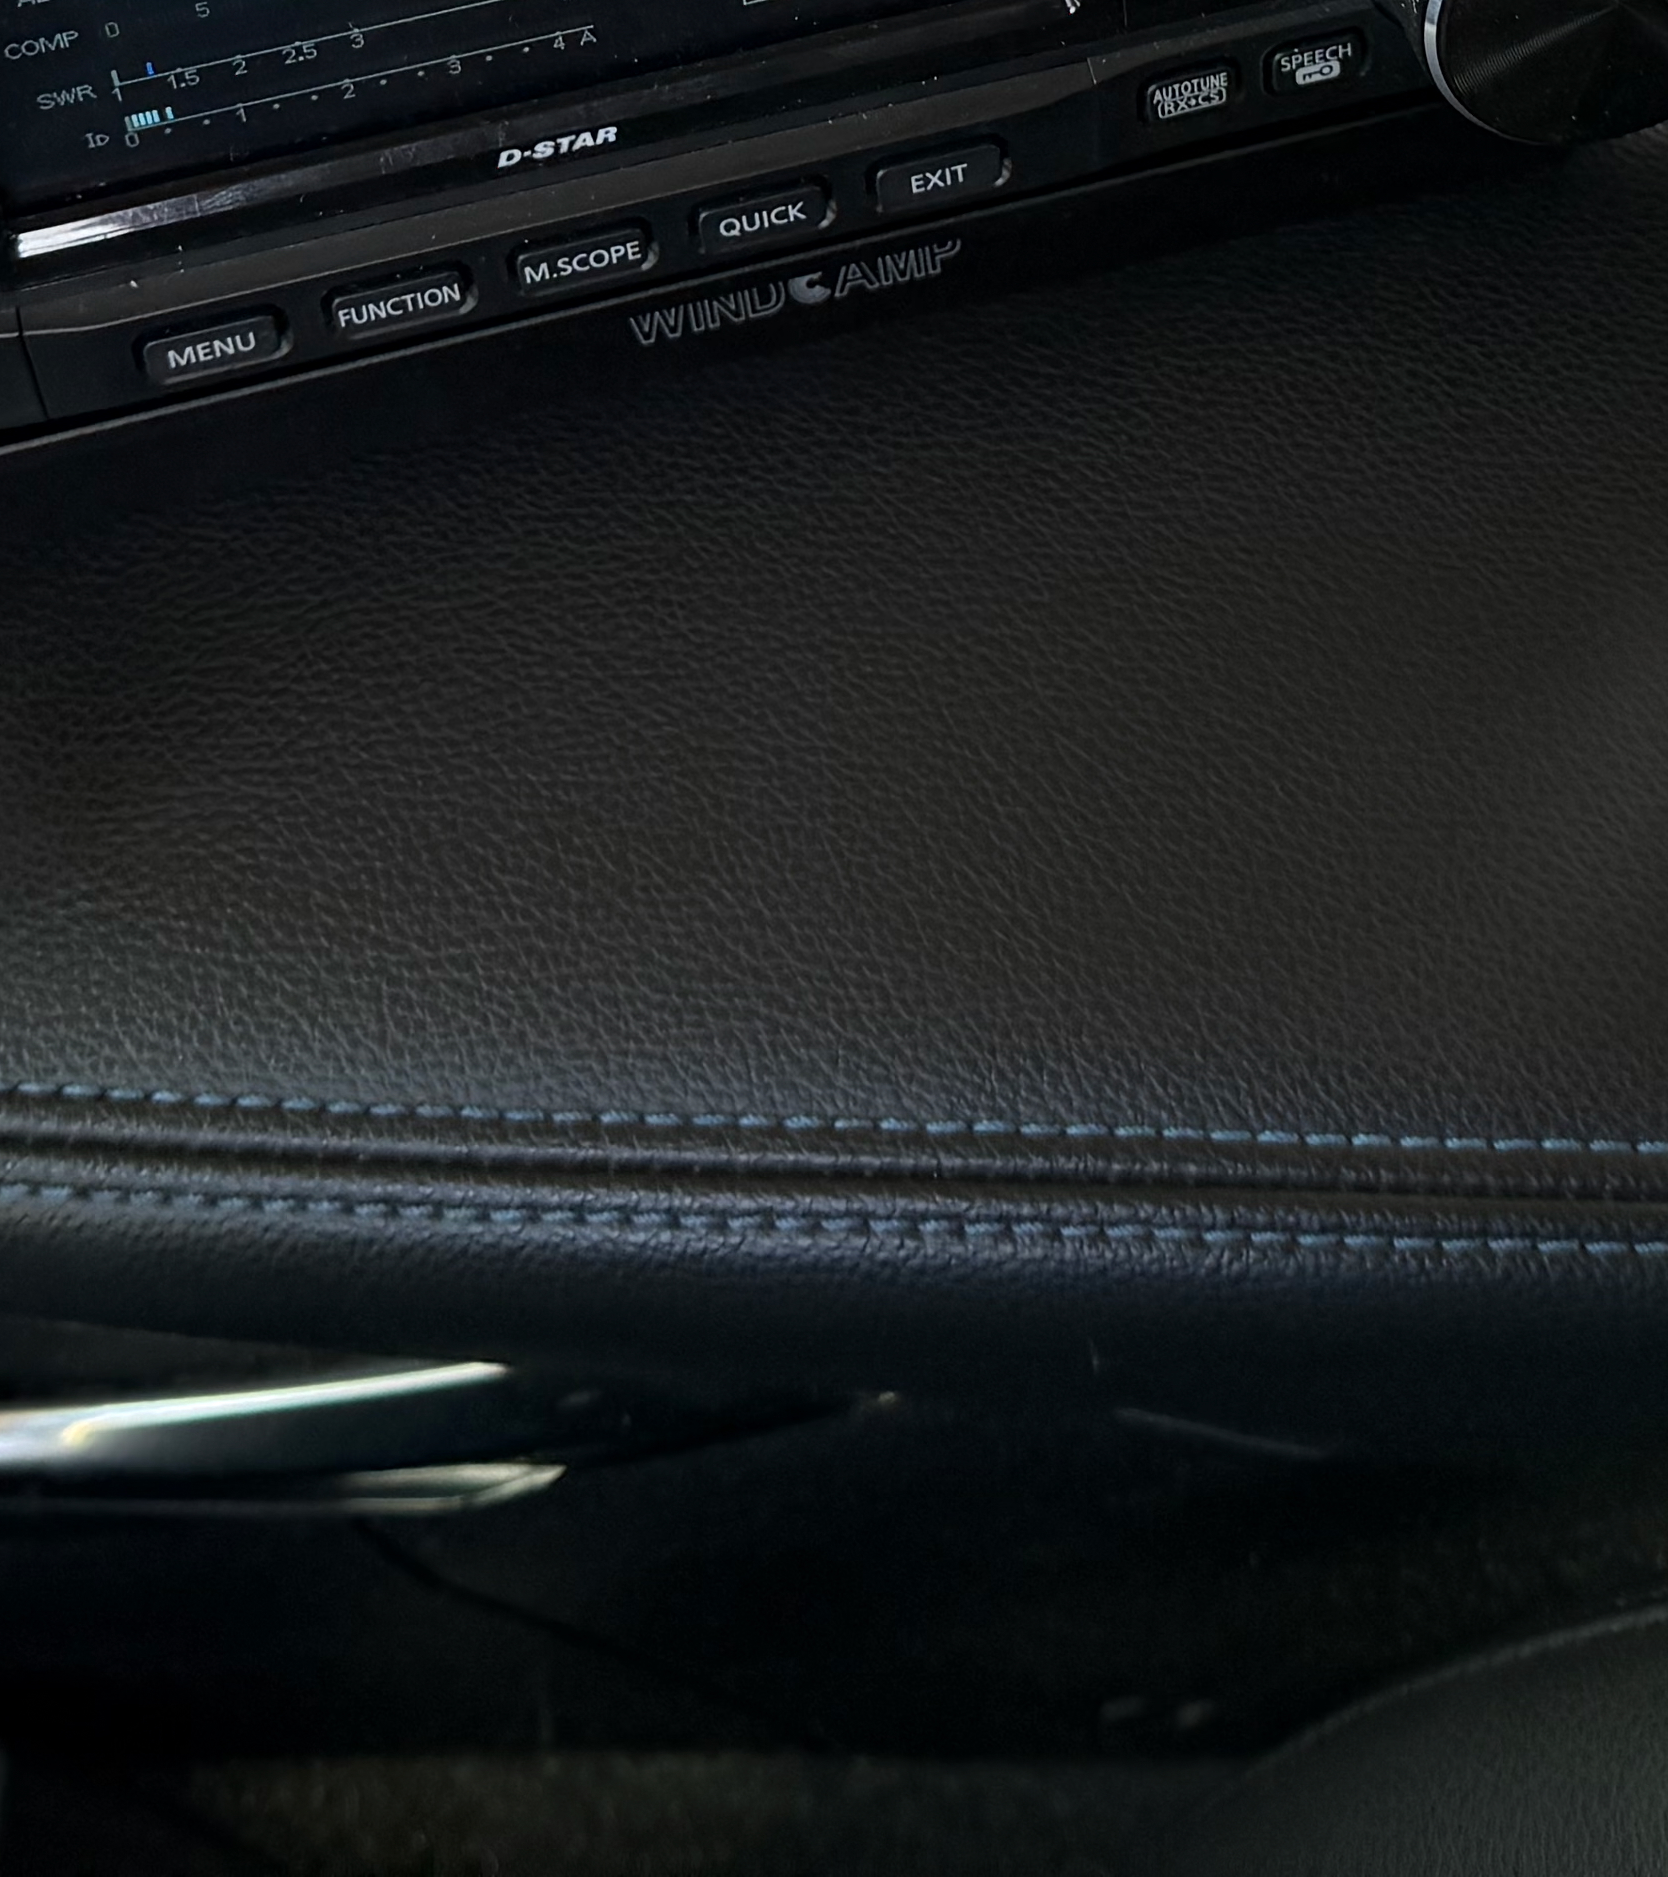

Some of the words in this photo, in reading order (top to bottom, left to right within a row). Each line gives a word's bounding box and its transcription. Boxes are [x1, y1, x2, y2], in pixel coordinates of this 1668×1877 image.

[2, 30, 80, 61] COMP
[194, 1, 211, 19] 5
[1280, 42, 1353, 73] SPEECH
[35, 82, 99, 111] SWR
[167, 68, 202, 90] 1.5
[233, 58, 250, 77] 2
[282, 42, 319, 65] 2.5
[350, 32, 367, 50] 3
[341, 81, 357, 100] 2
[446, 57, 464, 76] 3
[552, 33, 567, 52] 4
[579, 29, 598, 48] A
[1152, 71, 1229, 105] AUTOTUNE
[495, 124, 620, 169] D-STAR
[166, 330, 257, 371] MENU
[337, 282, 462, 330] FUNCTION
[523, 239, 643, 285] M.SCOPE
[718, 201, 808, 239] QUICK
[910, 162, 969, 196] EXIT
